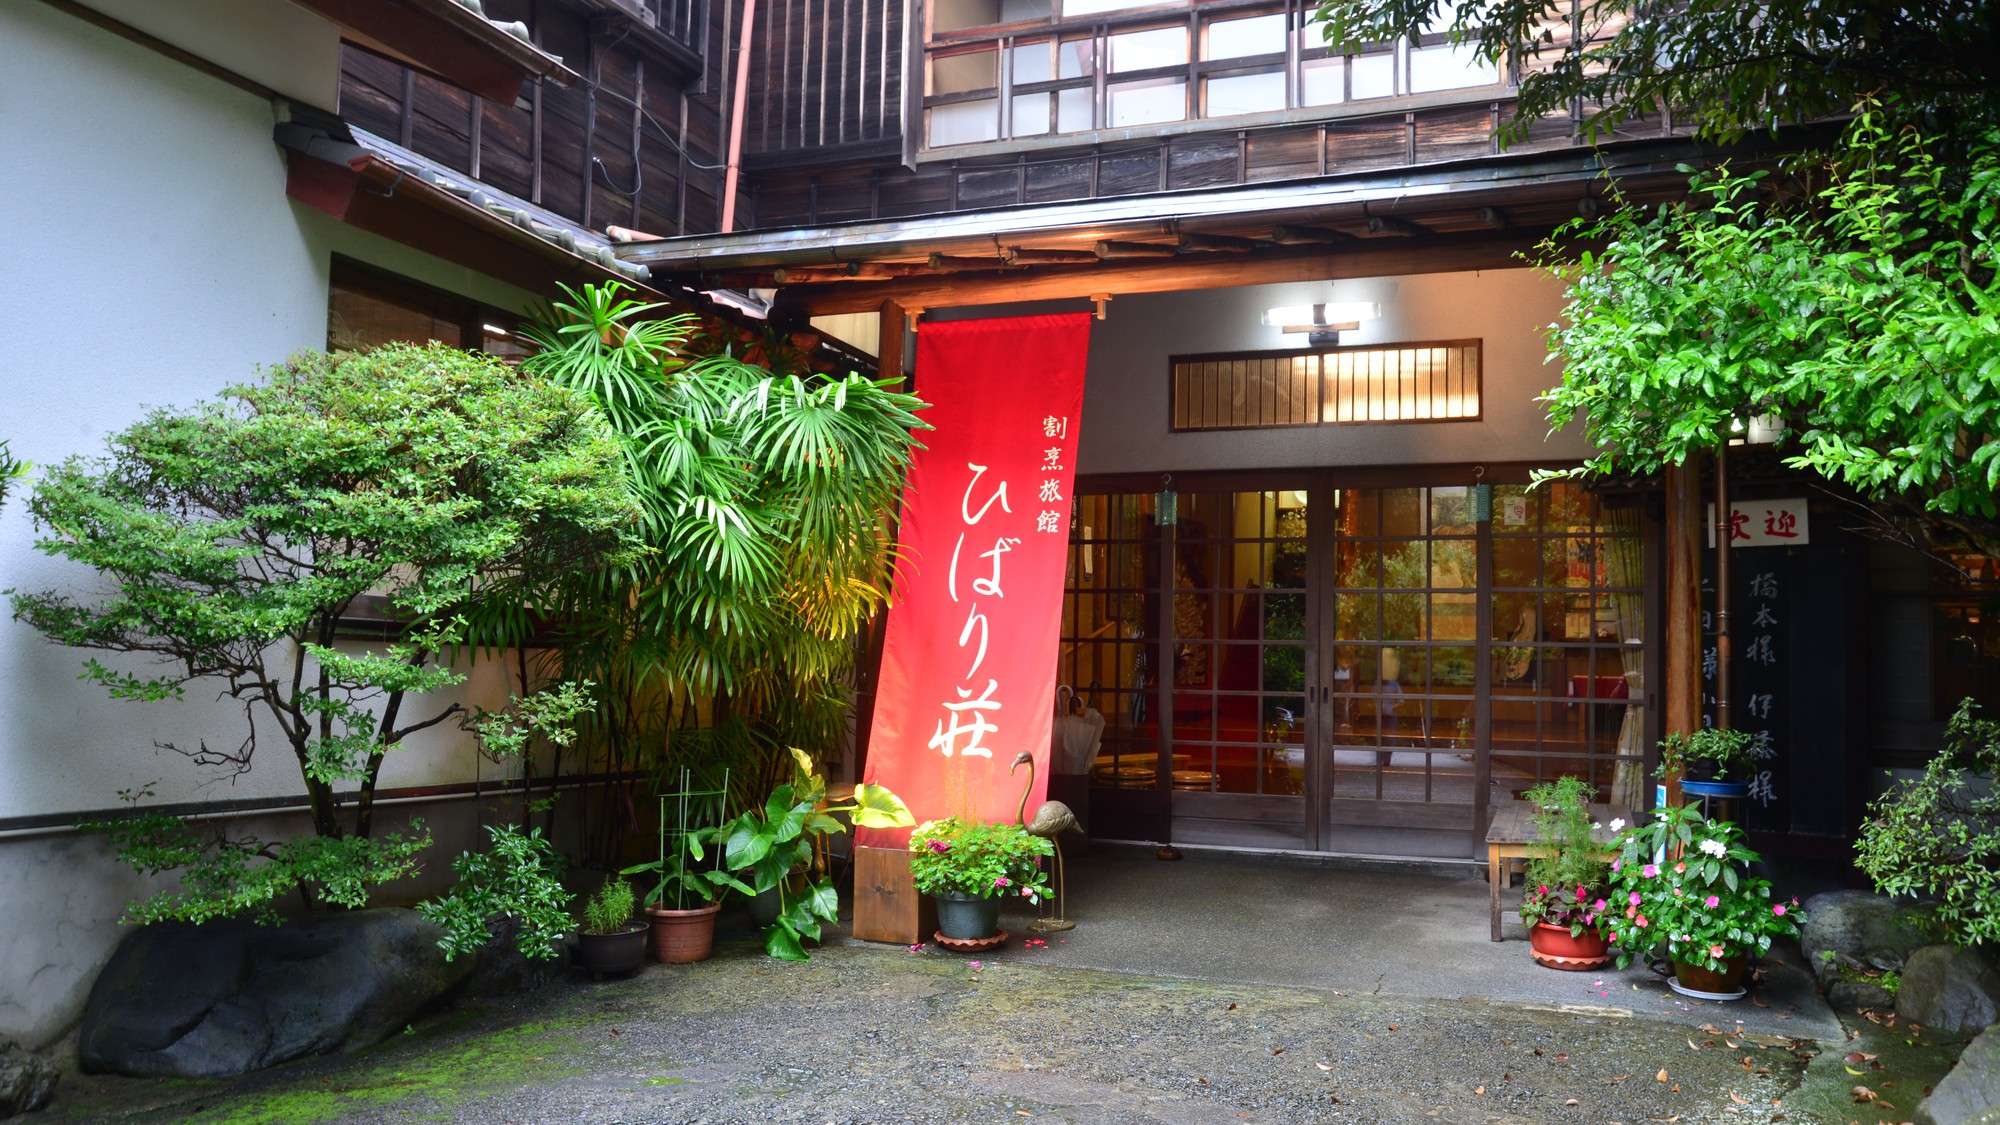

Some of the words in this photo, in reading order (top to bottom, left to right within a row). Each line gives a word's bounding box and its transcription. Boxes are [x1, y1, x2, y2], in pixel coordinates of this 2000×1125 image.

[1036, 415, 1068, 534] 割烹旅館
[927, 461, 1022, 758] ひばり荘
